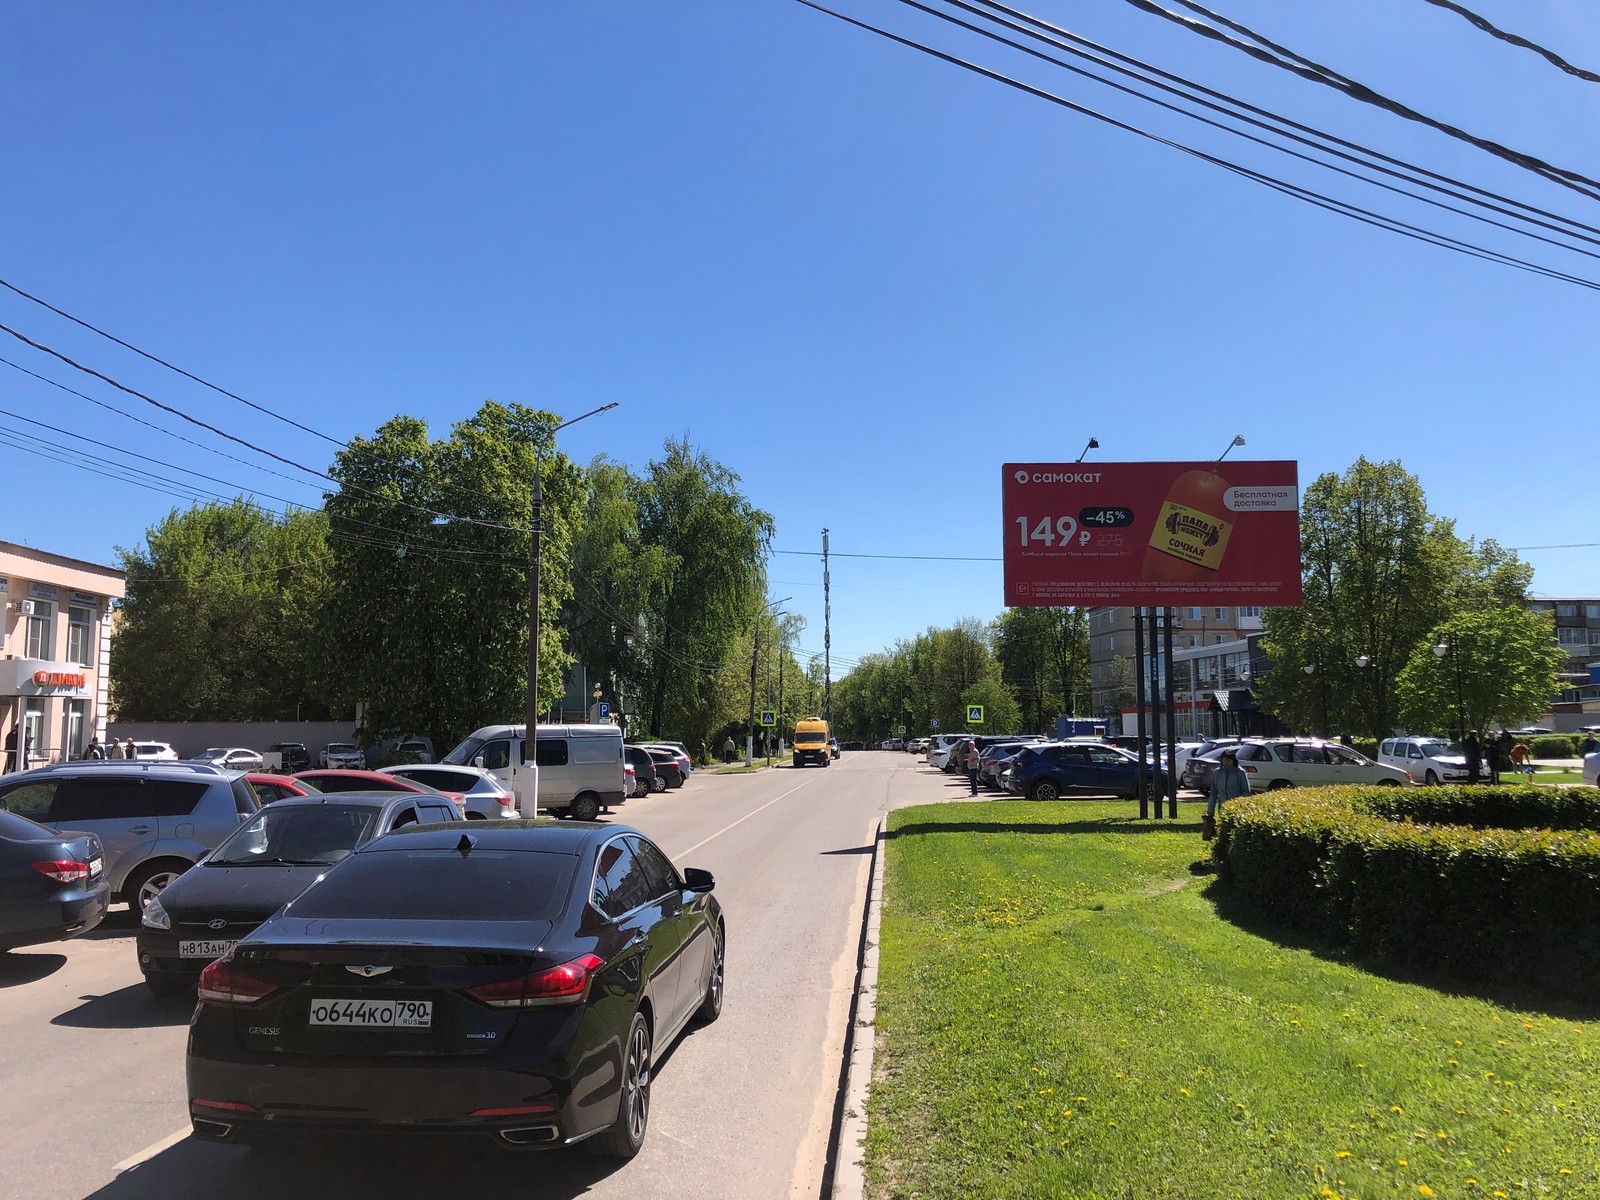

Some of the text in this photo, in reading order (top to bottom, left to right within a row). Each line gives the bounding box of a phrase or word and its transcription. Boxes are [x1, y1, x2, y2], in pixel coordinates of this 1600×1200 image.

[1032, 473, 1102, 483] самокат
[1233, 490, 1288, 499] Бесплатная
[1182, 515, 1209, 531] ПАПА
[1180, 526, 1204, 539] МОЖЕТ
[1168, 538, 1206, 557] СОЧНАЯ
[182, 942, 225, 954] Н813АН
[315, 1002, 426, 1024] О644КО 790
[248, 1026, 281, 1036] GENESIS
